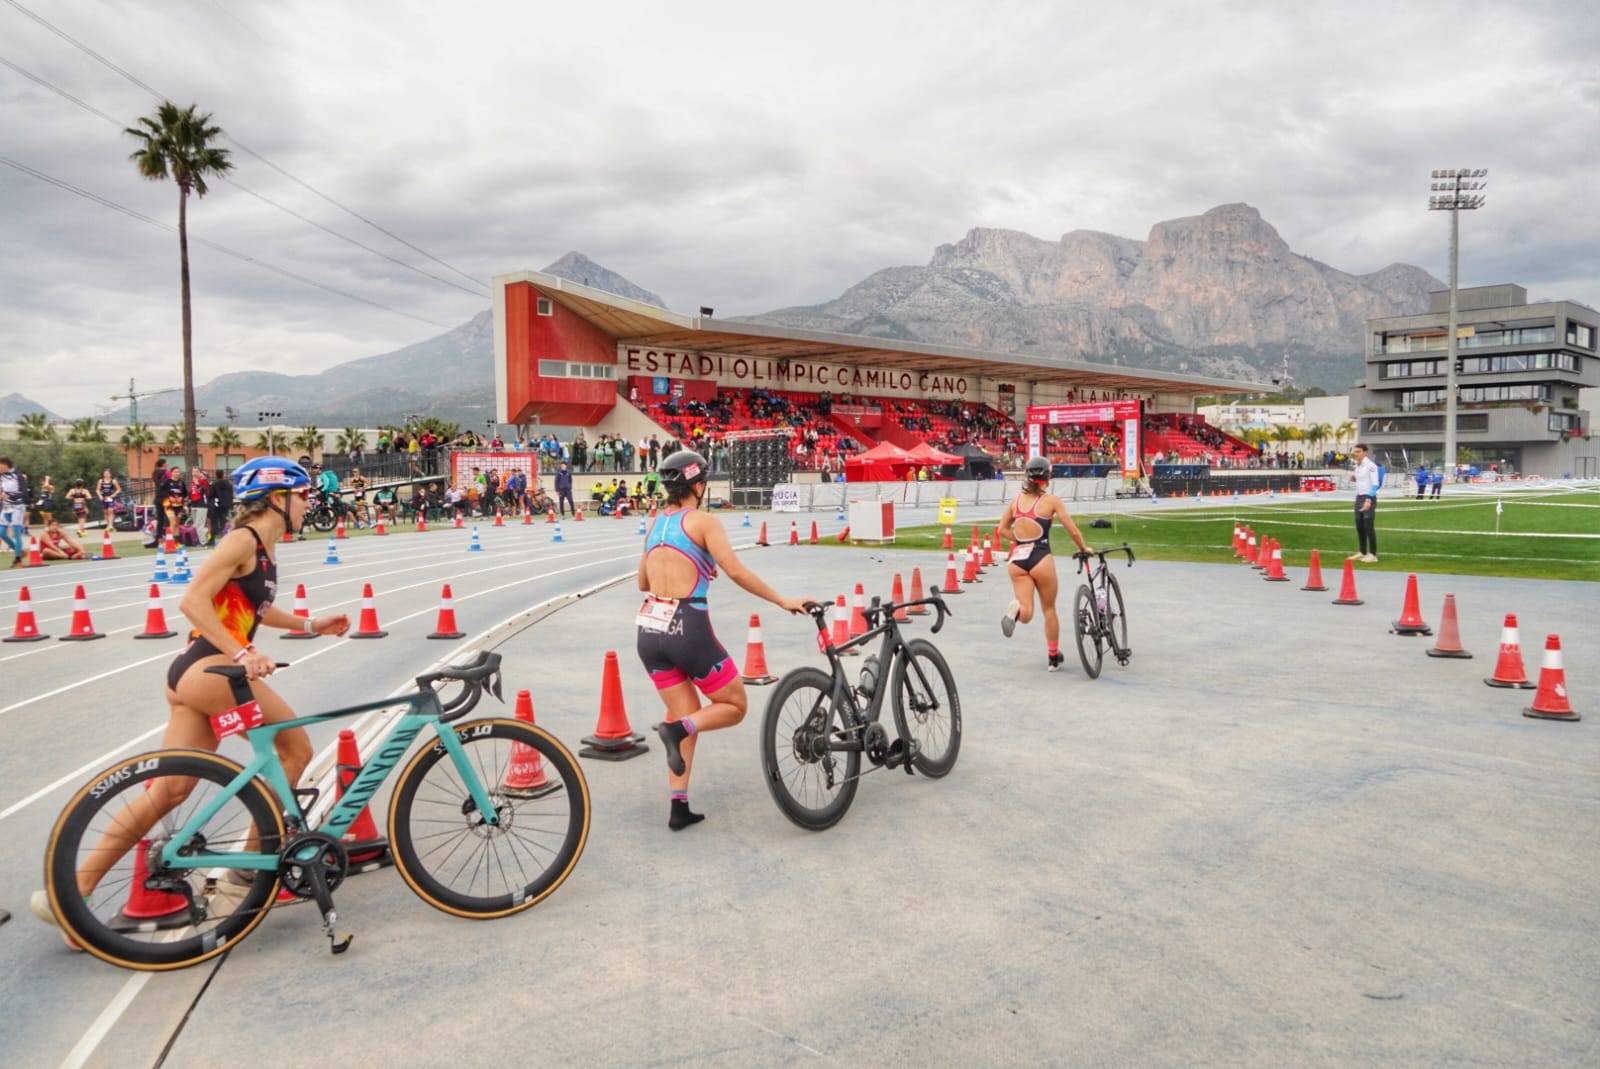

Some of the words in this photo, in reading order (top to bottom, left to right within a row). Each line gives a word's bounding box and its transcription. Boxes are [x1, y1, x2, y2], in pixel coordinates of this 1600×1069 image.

[627, 350, 722, 376] ESTADI
[733, 359, 829, 385] OLIMPIC
[837, 368, 912, 390] CAMILO
[919, 373, 967, 395] CANO
[1081, 389, 1097, 403] LA
[218, 711, 242, 727] 53A
[472, 724, 494, 737] DT
[134, 757, 159, 774] DT
[89, 766, 131, 799] SWISS
[329, 727, 419, 827] CANYON
